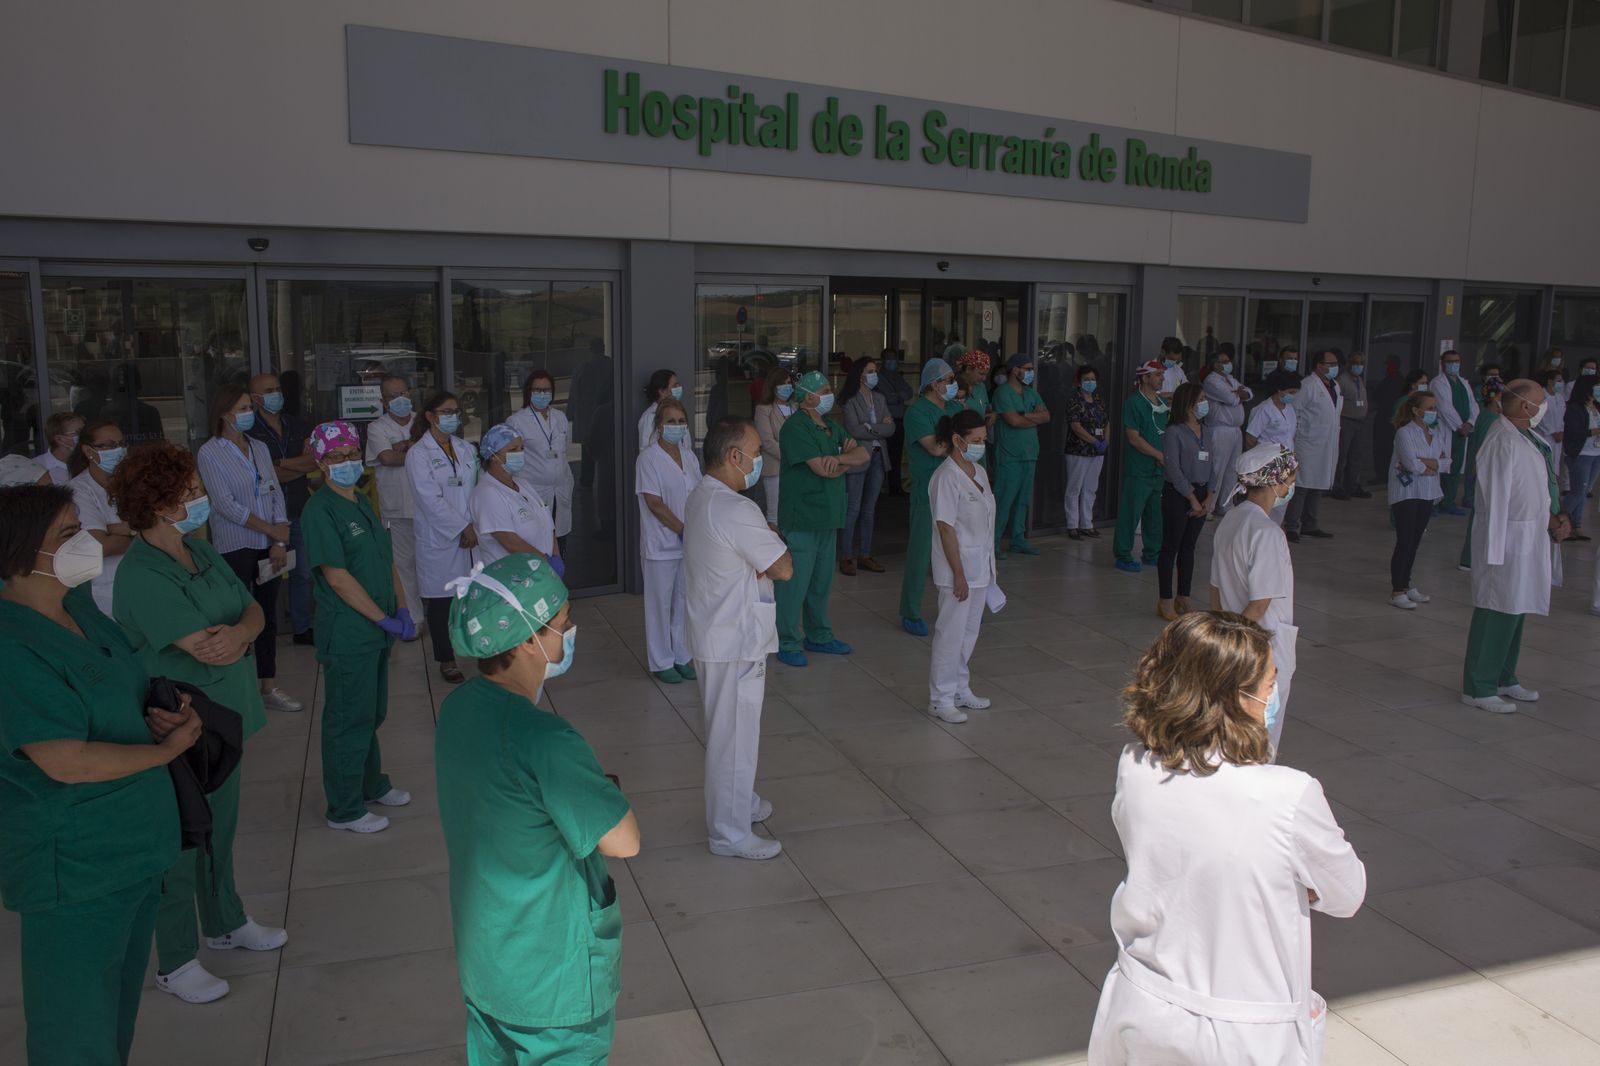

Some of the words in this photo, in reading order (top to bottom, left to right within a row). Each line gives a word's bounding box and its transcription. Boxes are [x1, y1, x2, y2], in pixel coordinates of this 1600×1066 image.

[604, 69, 798, 156] Hospital
[812, 96, 864, 156] de
[875, 104, 910, 160] la
[921, 109, 1072, 178] Serranía
[1080, 132, 1117, 182] de
[1125, 138, 1212, 193] Ronda
